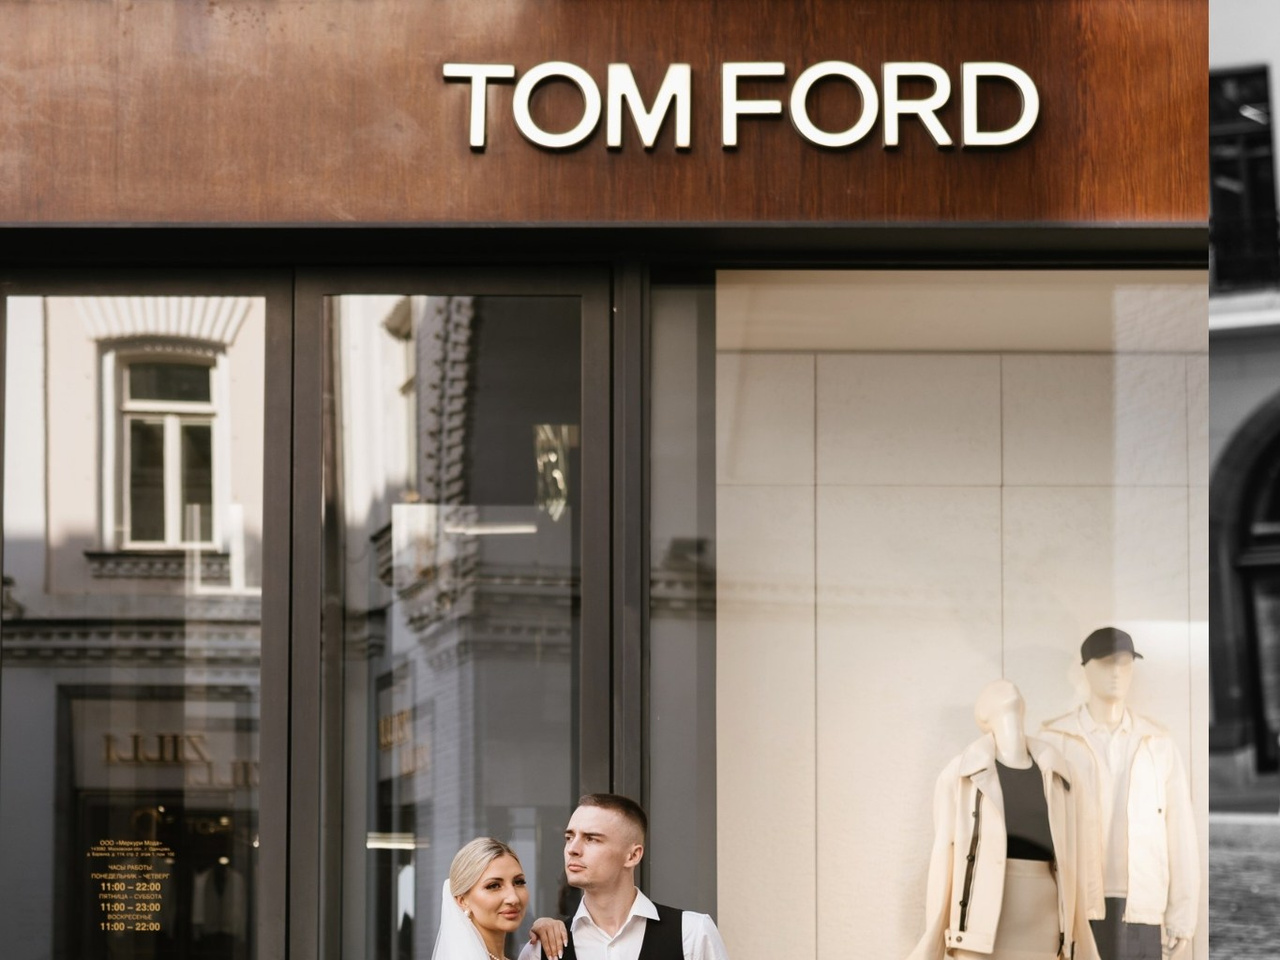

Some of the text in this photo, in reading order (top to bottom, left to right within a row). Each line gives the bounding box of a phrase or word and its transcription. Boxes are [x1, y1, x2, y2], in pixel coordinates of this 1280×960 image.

[443, 60, 1040, 150] TOM FORD
[101, 883, 125, 891] 11:00
[136, 883, 161, 891] 22:00
[101, 903, 125, 911] 11:00
[135, 903, 161, 911] 23:00
[101, 922, 125, 931] 11:00
[135, 922, 160, 931] 22:00
